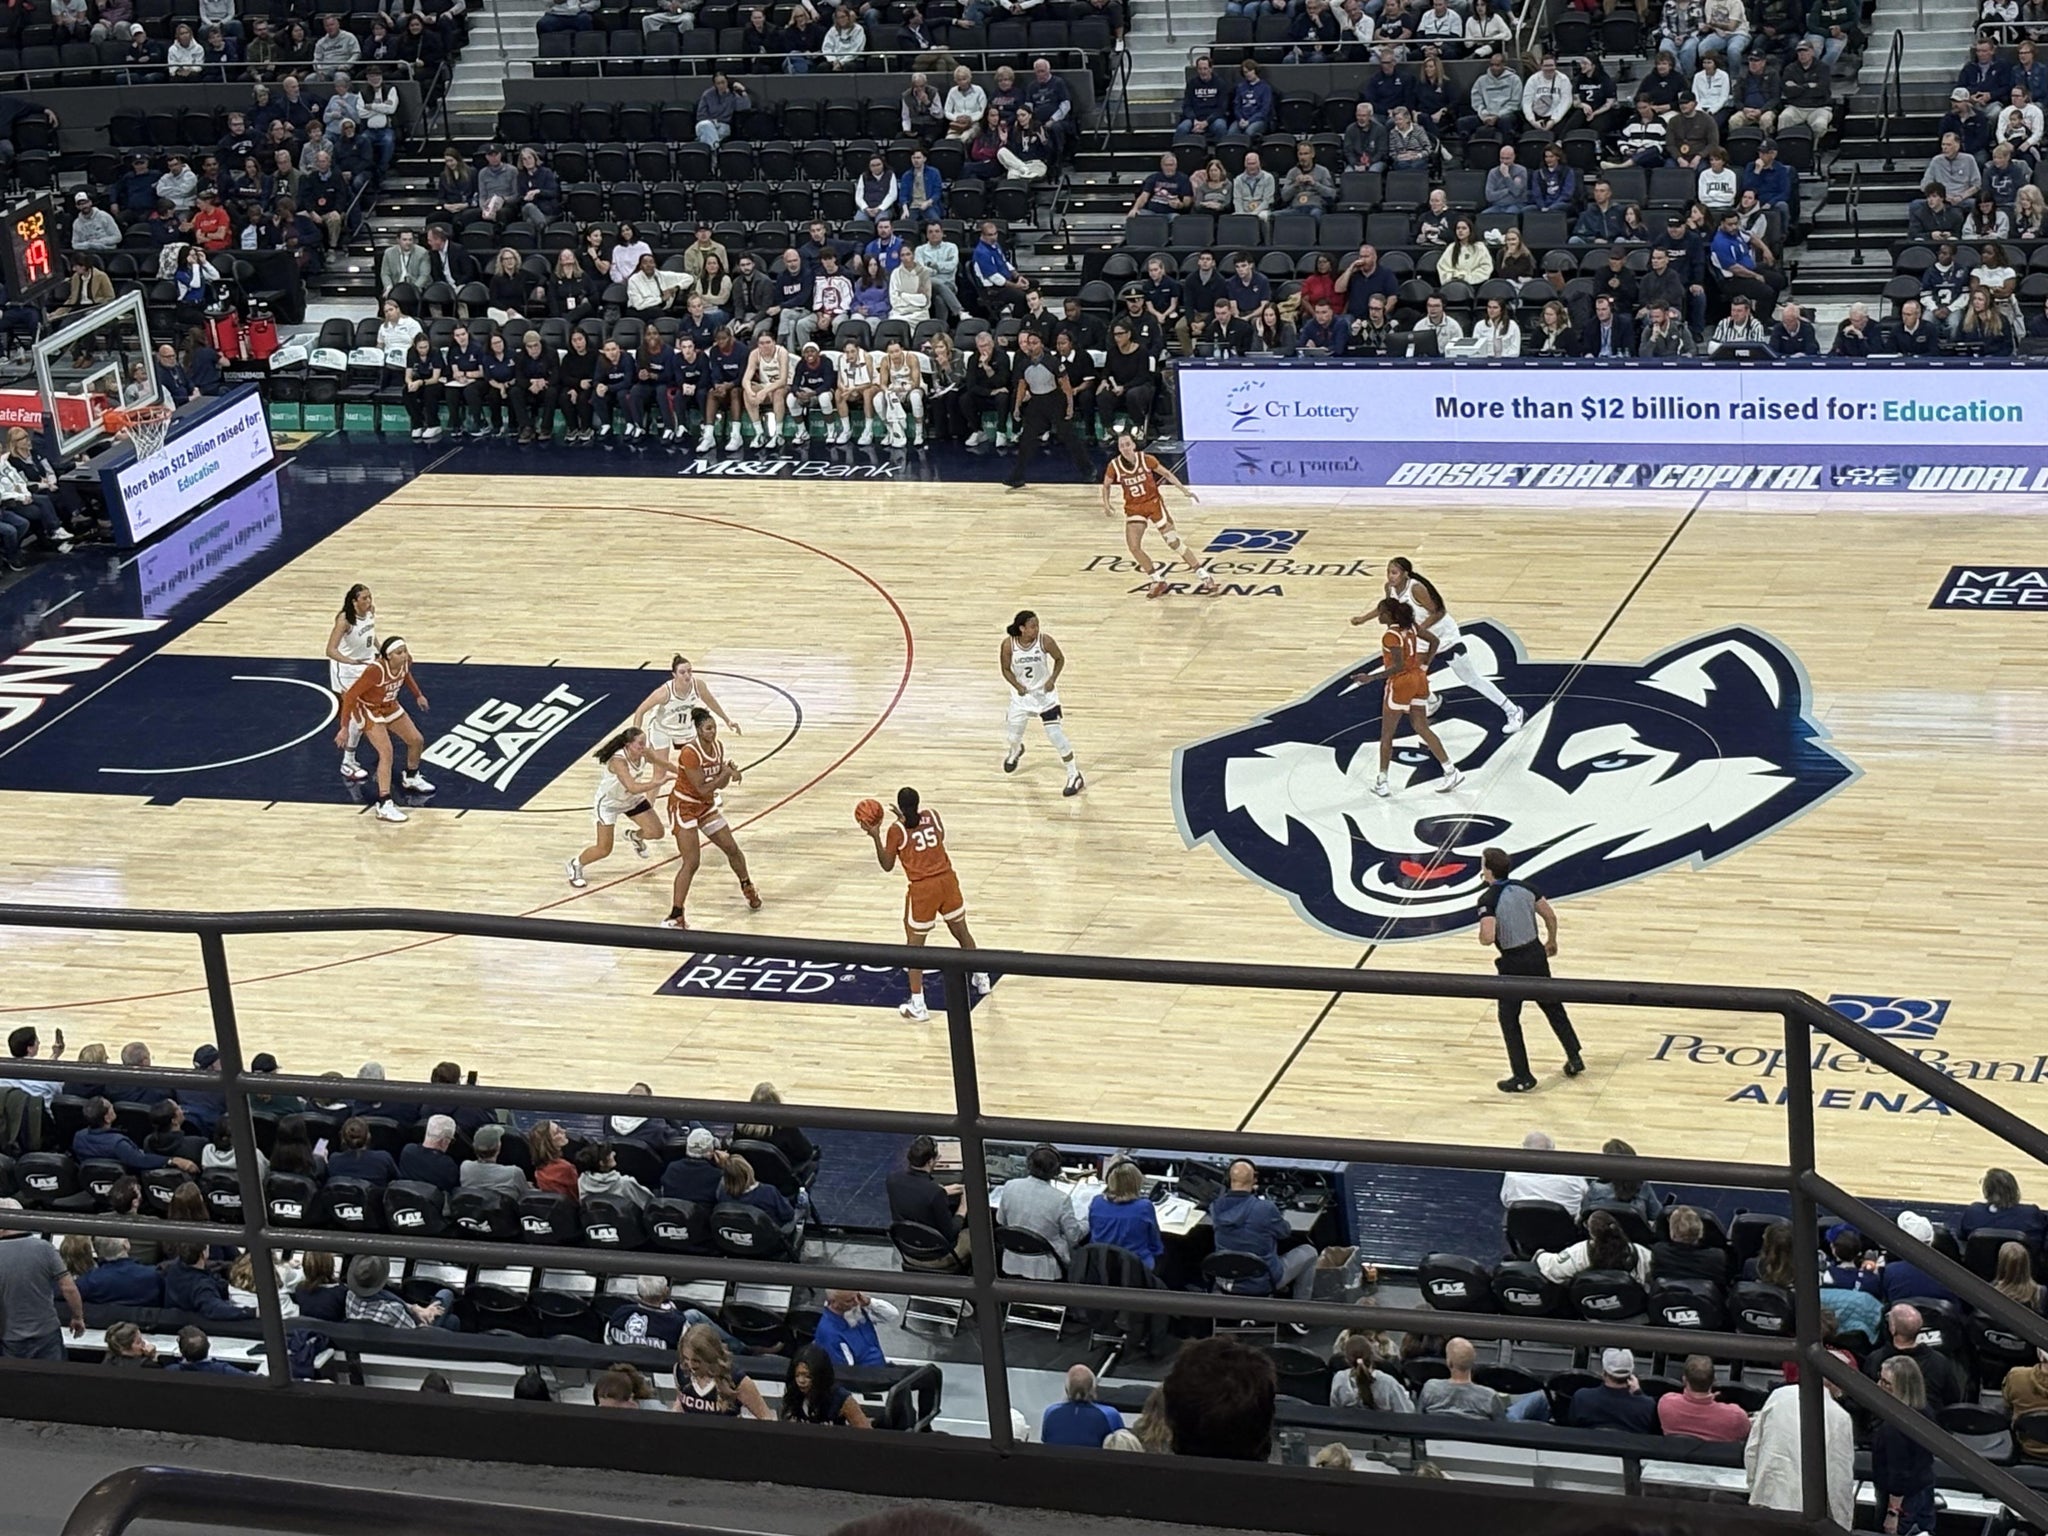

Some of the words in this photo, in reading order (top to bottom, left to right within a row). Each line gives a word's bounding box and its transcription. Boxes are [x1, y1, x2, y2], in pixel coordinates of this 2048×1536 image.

[1294, 401, 1360, 422] Lottery
[1435, 397, 1504, 419] More
[1512, 396, 1573, 419] than
[1581, 396, 1625, 421] $12
[1632, 396, 1720, 420] billion
[1729, 397, 1818, 420] raised
[1827, 397, 1877, 421] for:
[1883, 399, 2023, 422] Education
[123, 478, 148, 501] More
[148, 465, 171, 486] than
[171, 453, 187, 473] $12
[186, 438, 216, 463] billion
[217, 418, 244, 444] raised
[678, 459, 797, 476] M&T
[792, 461, 902, 477] Bank
[1386, 462, 1640, 488] BASKETBALL
[1648, 464, 1823, 490] CAPITAL
[1847, 467, 1898, 477] OF
[177, 460, 220, 493] Education
[1833, 476, 1898, 486] THE
[1130, 484, 1146, 497] 21
[1024, 666, 1033, 678] 2
[420, 698, 523, 769] BIG
[455, 683, 585, 783] EAST
[911, 826, 938, 851] 35
[274, 1203, 302, 1216] LAZ
[397, 1212, 423, 1225] LAZ
[1432, 1282, 1466, 1294] LAZ
[1667, 1310, 1699, 1322] LAZ
[1916, 1330, 1942, 1344] AZ
